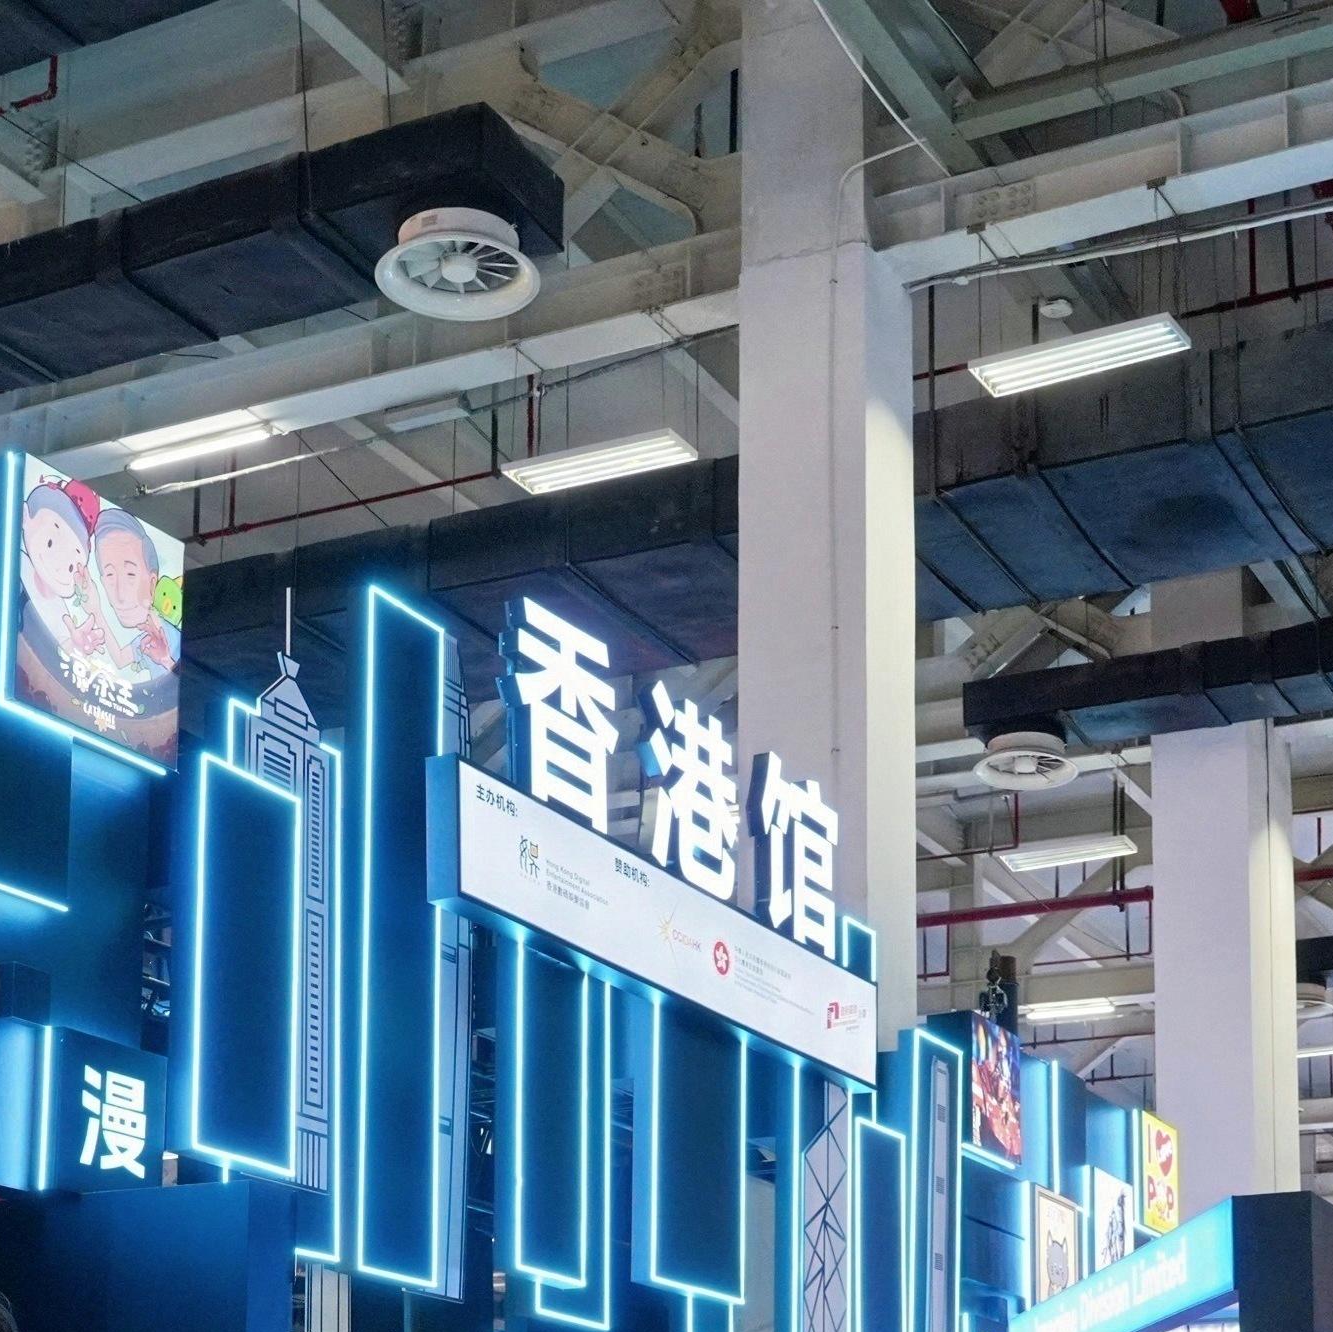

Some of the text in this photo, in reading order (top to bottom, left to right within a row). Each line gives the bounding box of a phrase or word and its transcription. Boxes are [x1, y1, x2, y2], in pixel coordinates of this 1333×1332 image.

[514, 596, 839, 960] 香港馆
[79, 1064, 148, 1181] 漫
